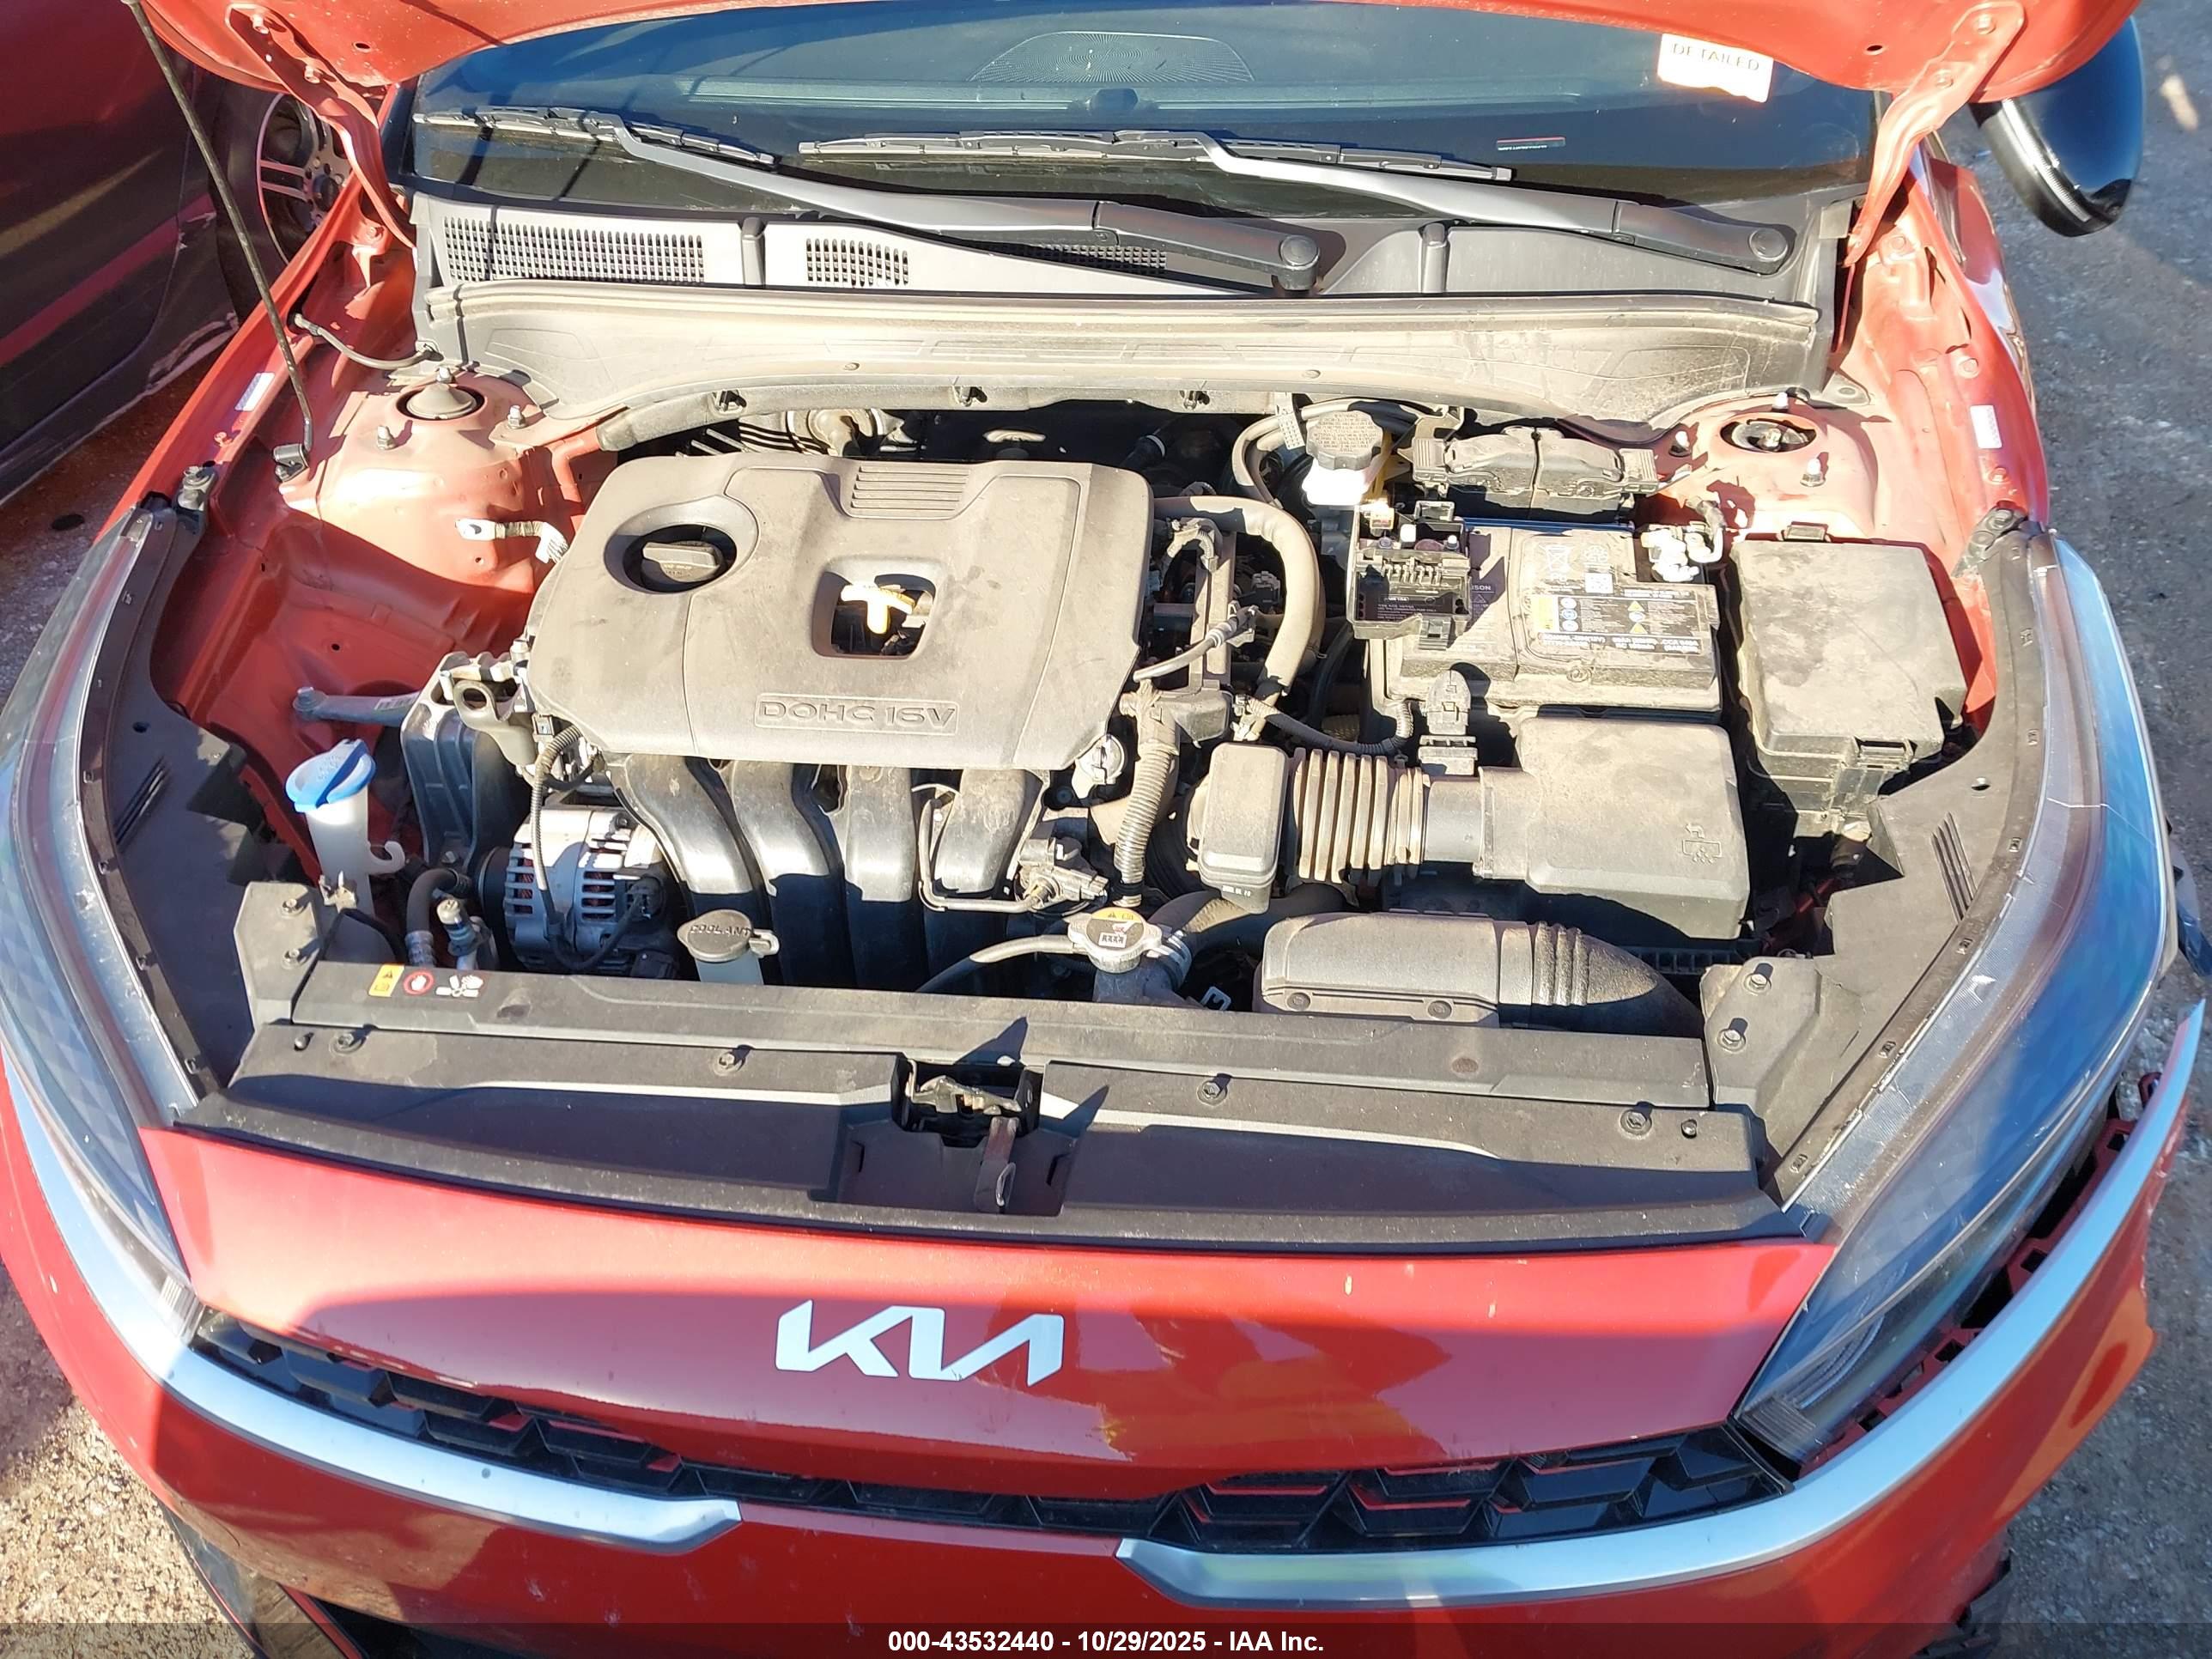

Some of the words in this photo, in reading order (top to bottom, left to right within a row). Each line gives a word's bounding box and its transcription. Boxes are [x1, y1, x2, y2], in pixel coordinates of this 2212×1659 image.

[1671, 43, 1759, 71] DETAILED
[758, 701, 876, 724] DOHC
[884, 706, 956, 728] 16V
[690, 923, 751, 937] COOLANT
[775, 1298, 1065, 1387] KIA
